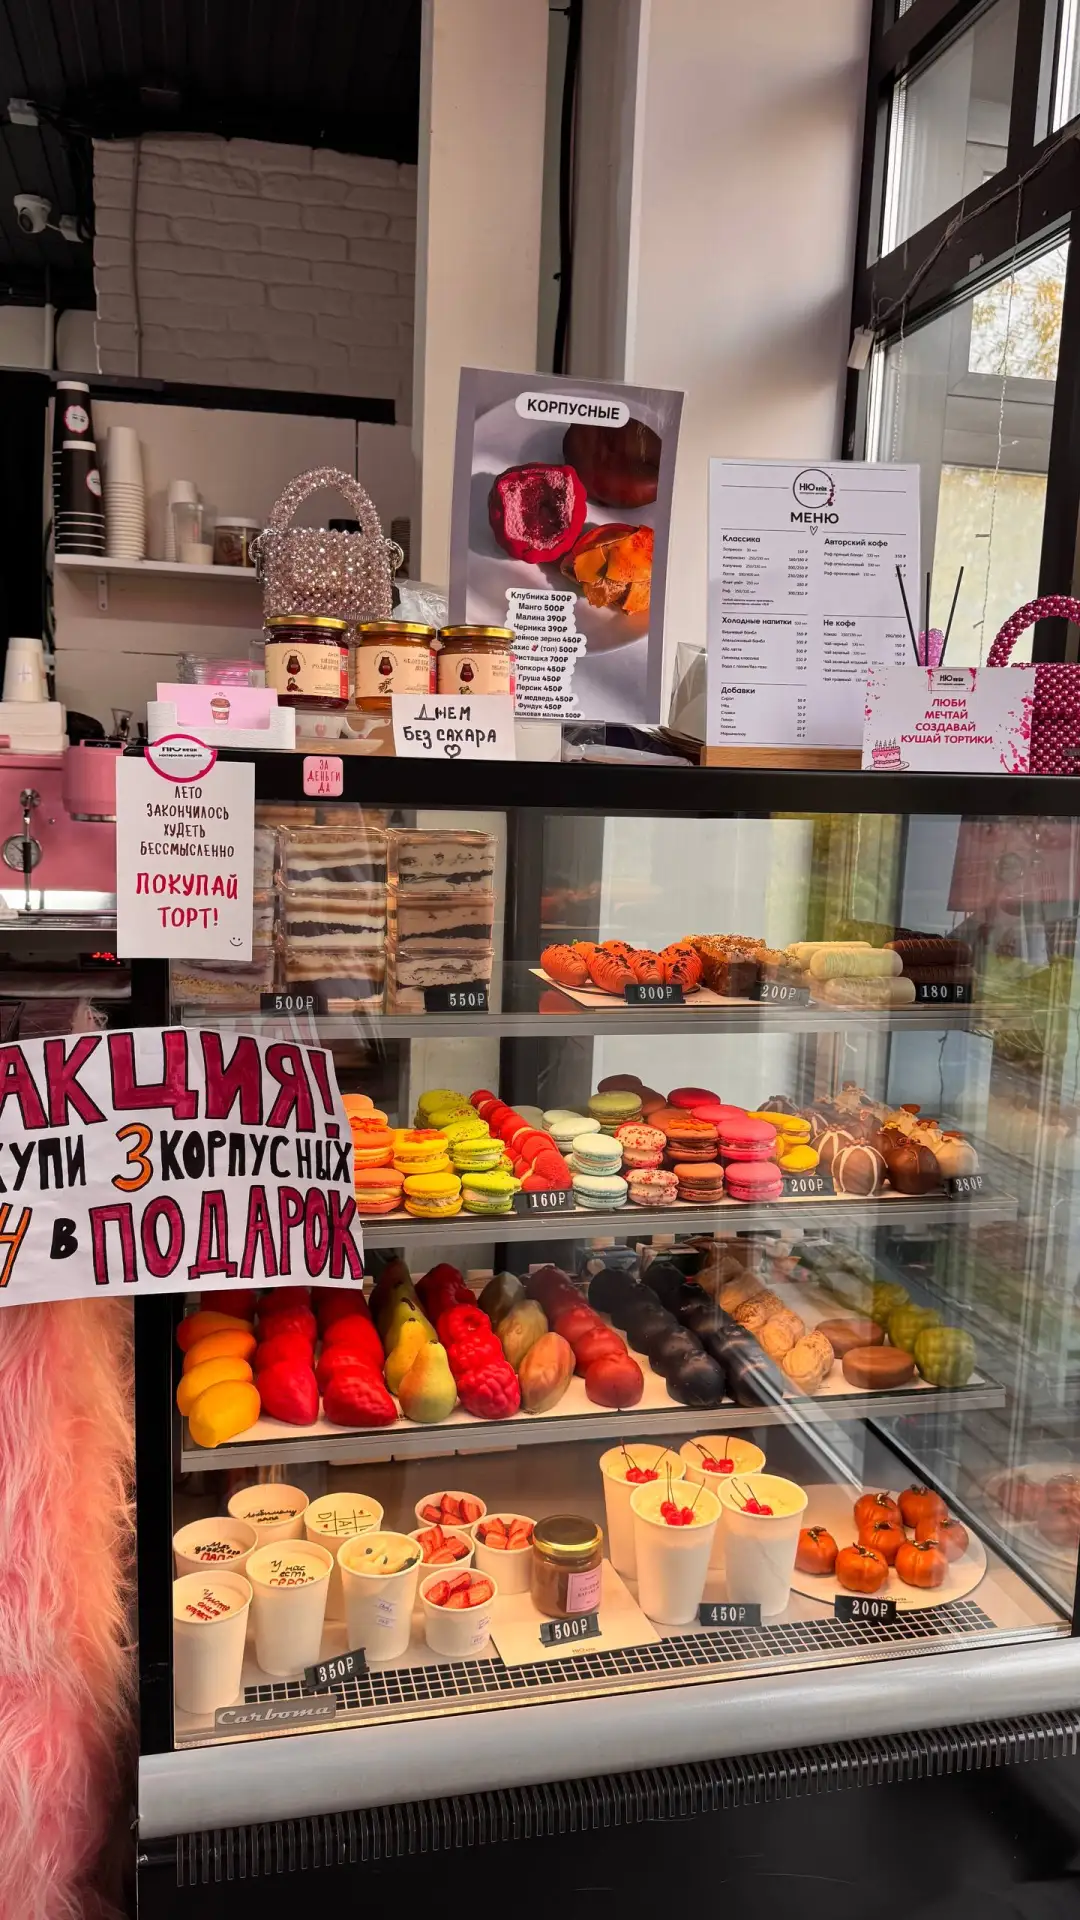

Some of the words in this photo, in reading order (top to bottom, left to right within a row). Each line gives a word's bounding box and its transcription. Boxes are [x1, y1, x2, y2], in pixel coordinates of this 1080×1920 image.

[527, 398, 620, 420] КОРПУСНЫЕ
[790, 512, 839, 524] МЕНЮ
[722, 534, 760, 543] Классика
[824, 538, 866, 546] Авторский
[511, 592, 549, 600] Клубника
[550, 594, 572, 602] 500₽
[516, 613, 545, 621] Малина
[722, 617, 760, 625] Холодные
[836, 620, 856, 628] кофе
[514, 623, 546, 632] Черника
[518, 674, 540, 682] Груша
[518, 702, 542, 710] Фундук
[932, 698, 966, 708] ЛЮБИ
[924, 709, 968, 720] МЕЧТАЙ
[915, 721, 976, 733] СОЗДАВАЙ
[403, 726, 432, 749] БЕЗ
[436, 728, 496, 748] САХАРА
[901, 734, 941, 744] КУШАЙ
[944, 736, 993, 744] ТОРТИКИ
[320, 759, 328, 770] ЗА
[307, 770, 340, 782] ДЕНЬГИ
[174, 786, 203, 799] ЛЕТО
[318, 782, 330, 793] ДА
[146, 803, 229, 820] ЗАКОНЧИЛОСЬ
[163, 822, 206, 838] ХУДЕТЬ
[140, 841, 234, 858] БЕССМЫСЛЕННО
[136, 872, 238, 900] ПОКУПАЙ
[157, 906, 219, 929] ТОРТ!
[450, 992, 485, 1006] 550₽
[638, 986, 673, 1000] 300₽
[760, 984, 797, 1000] 200₽
[275, 996, 314, 1011] 500₽
[0, 1030, 340, 1139] АКЦИЯ!
[111, 1122, 153, 1192] 3
[160, 1130, 352, 1184] КОРПУСНЫХ
[791, 1178, 823, 1192] 200₽
[956, 1176, 983, 1192] 280₽
[532, 1192, 565, 1208] 160₽
[88, 1184, 364, 1286] ПОДАРОК
[711, 1607, 746, 1622] 450₽
[852, 1600, 888, 1617] 200₽
[555, 1618, 588, 1639] 500₽
[320, 1656, 355, 1683] 350₽
[217, 1706, 330, 1724] Carboma
